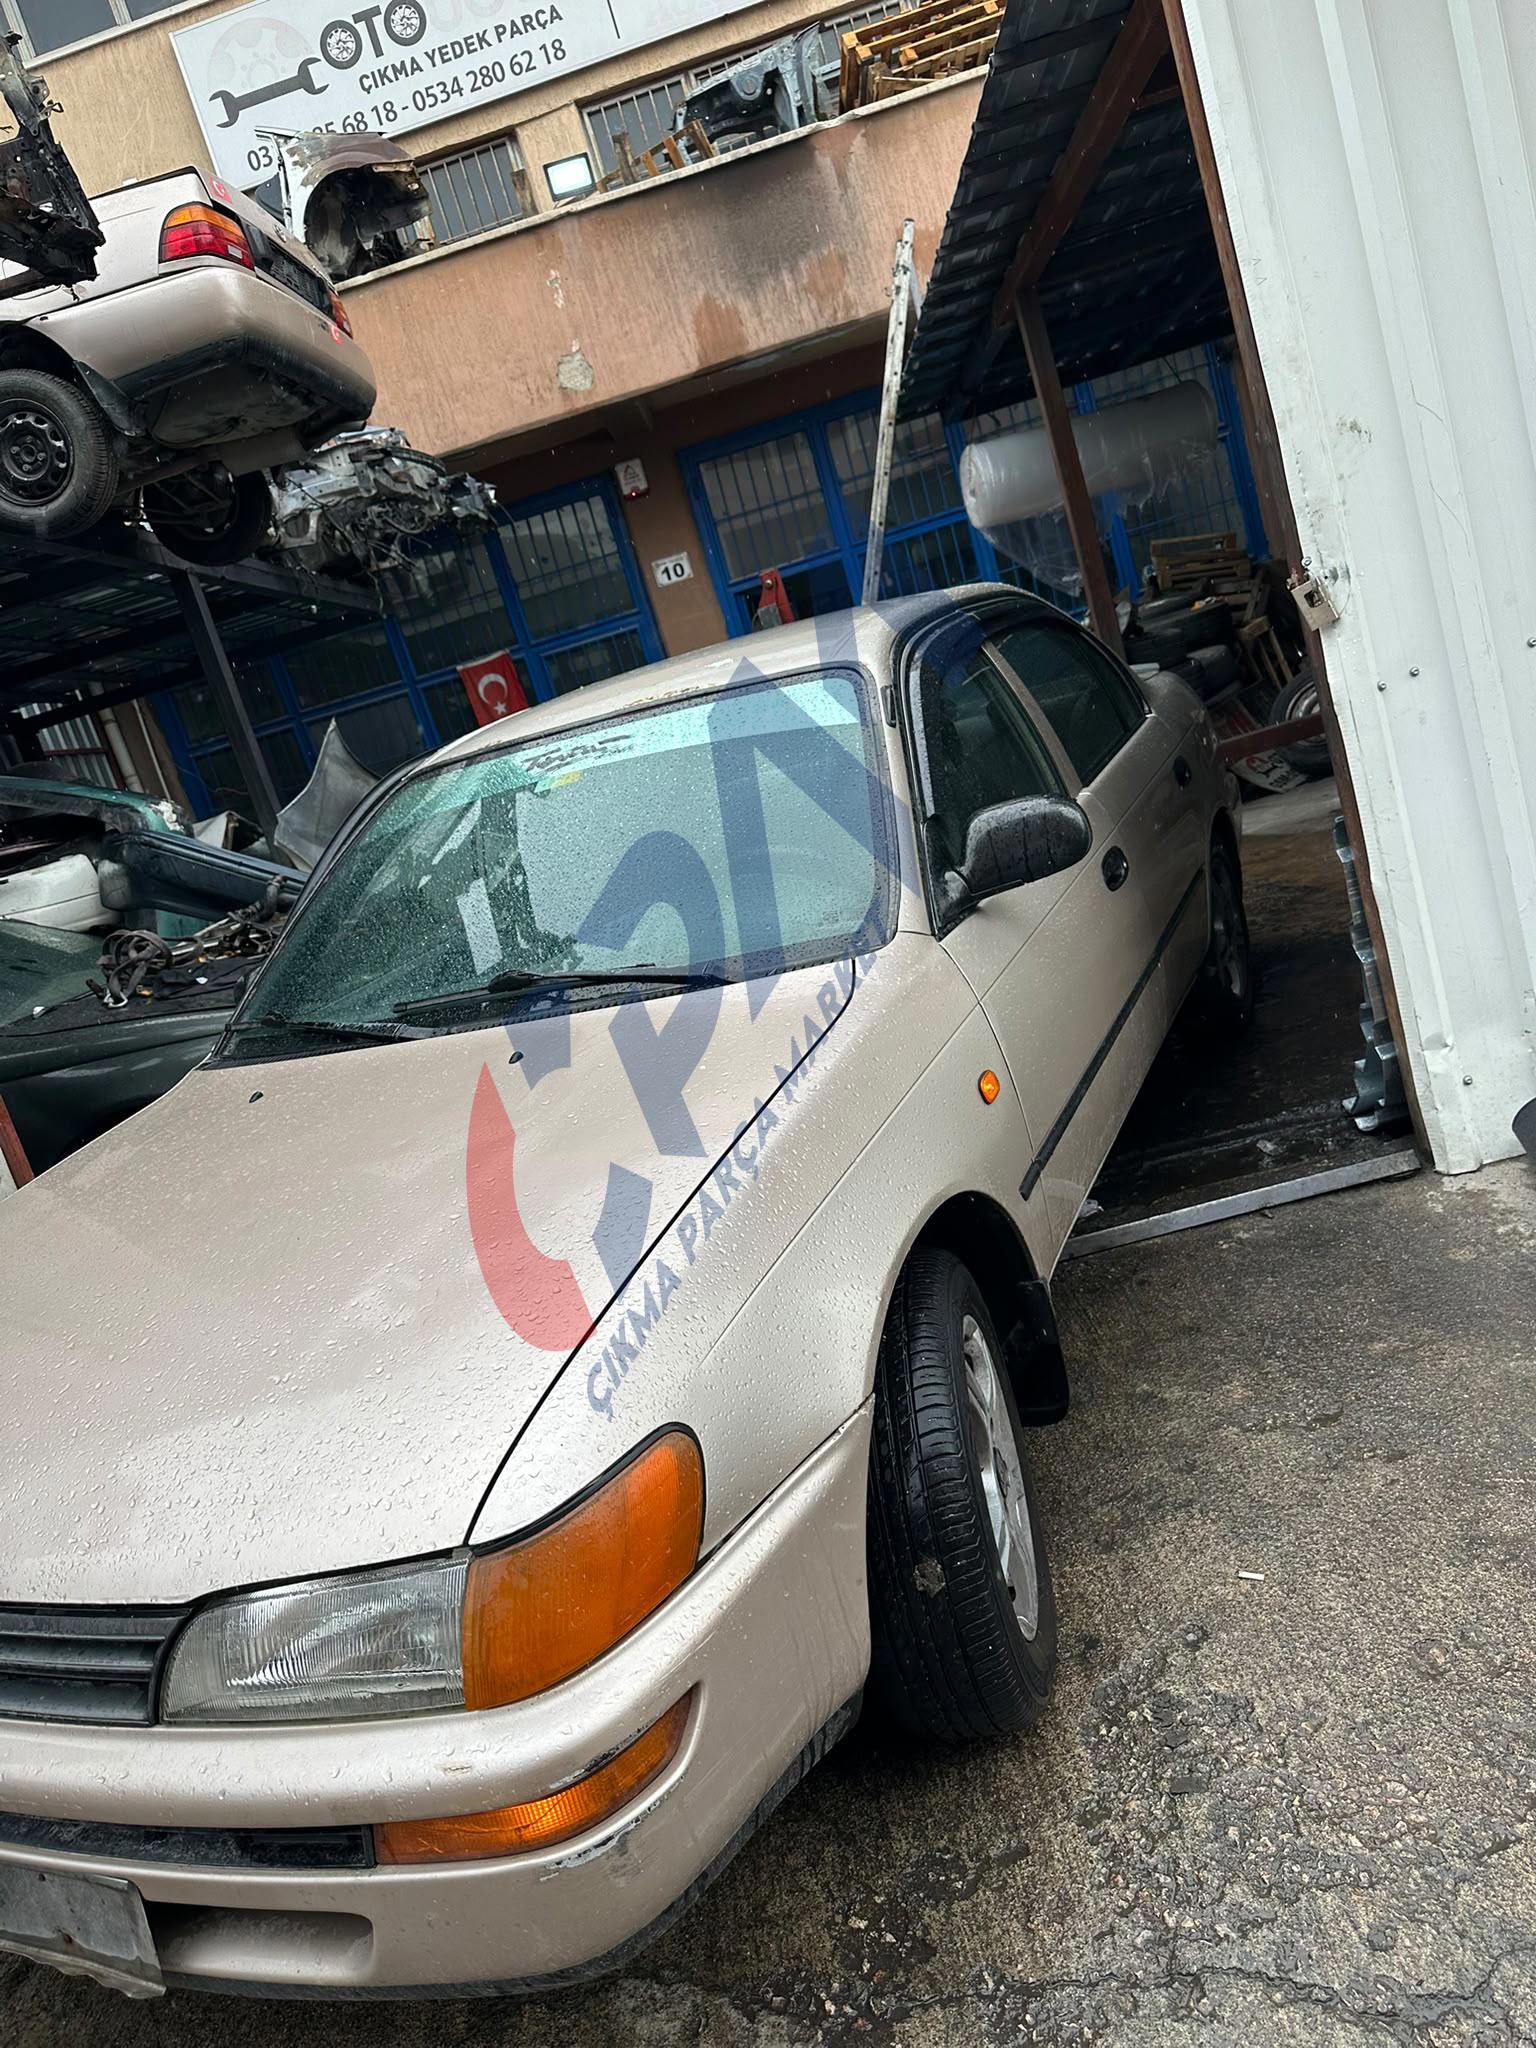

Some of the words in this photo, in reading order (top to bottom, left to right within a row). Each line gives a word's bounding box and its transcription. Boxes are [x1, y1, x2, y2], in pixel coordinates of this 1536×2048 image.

[320, 0, 426, 70] OTO
[358, 56, 424, 94] ÇIKMA
[424, 29, 492, 68] YEDEK
[494, 5, 564, 43] PARÇA
[371, 100, 398, 126] 18
[412, 76, 464, 112] 0534
[466, 61, 505, 93] 280
[509, 50, 537, 76] 62
[539, 39, 567, 65] 18
[661, 563, 684, 581] 10
